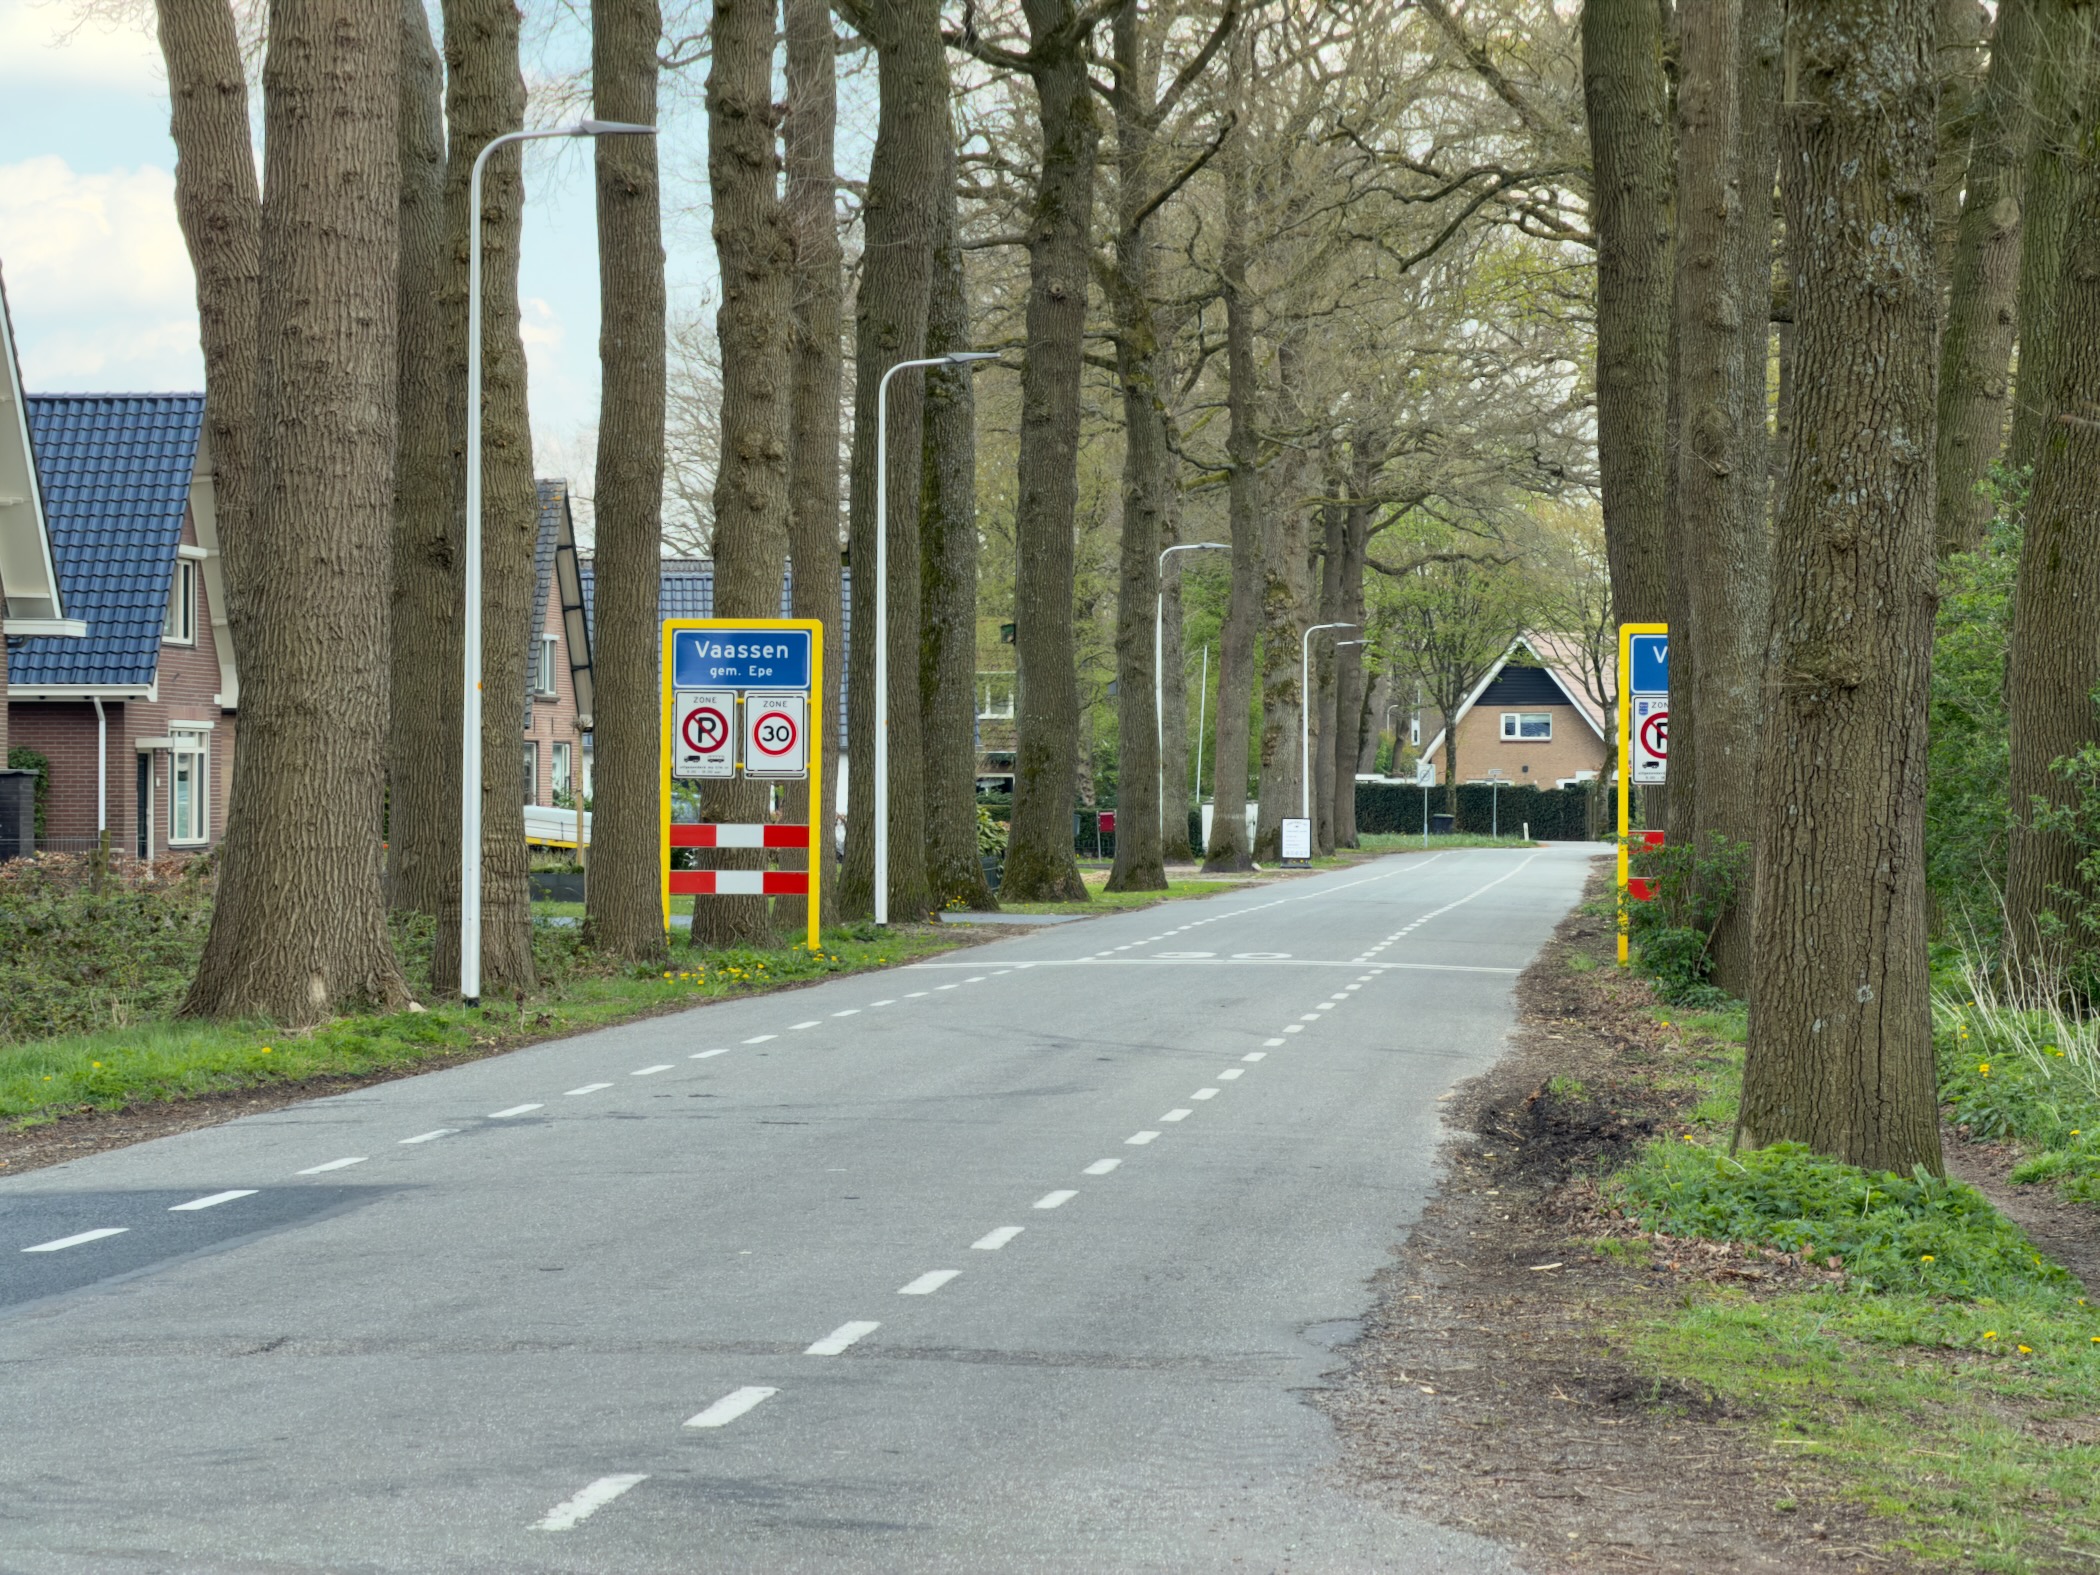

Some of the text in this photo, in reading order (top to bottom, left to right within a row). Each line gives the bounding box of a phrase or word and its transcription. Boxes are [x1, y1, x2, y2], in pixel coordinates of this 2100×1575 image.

[695, 641, 788, 659] Vaassen
[710, 665, 773, 679] gem. Epe
[693, 696, 717, 704] ZONE
[763, 700, 788, 708] ZONE
[698, 717, 716, 743] P
[762, 725, 790, 742] 30
